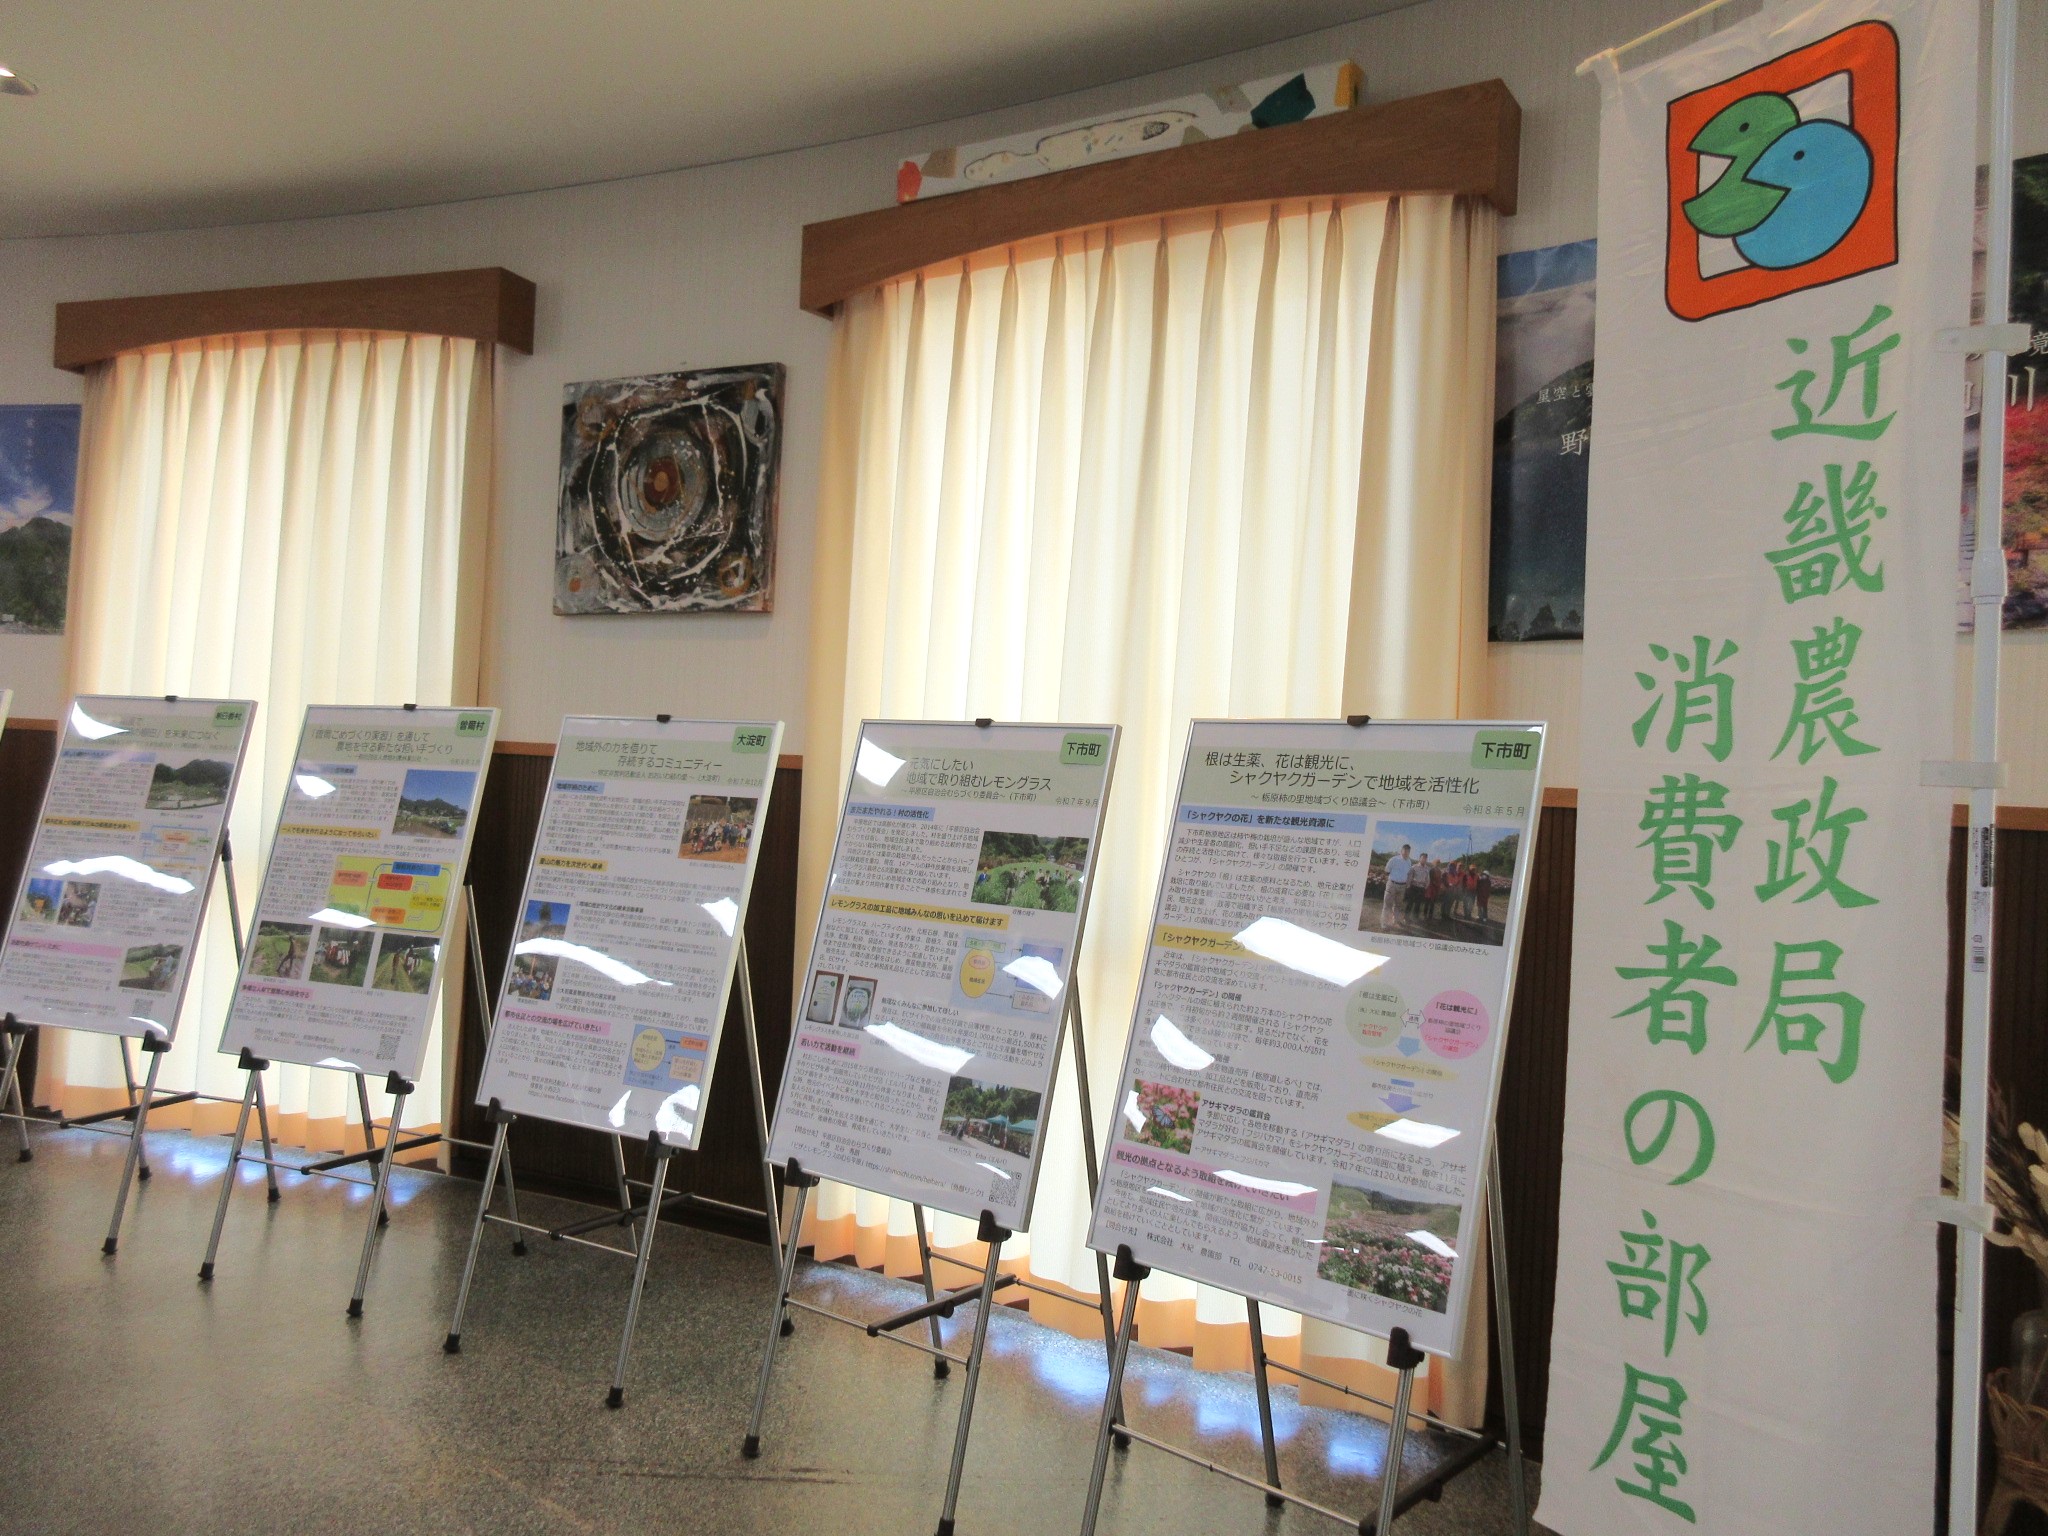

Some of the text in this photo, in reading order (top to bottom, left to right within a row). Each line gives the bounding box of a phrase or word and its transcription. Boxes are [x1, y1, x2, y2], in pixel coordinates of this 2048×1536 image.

[1560, 429, 1589, 456] 野
[1745, 305, 1901, 1084] 近畿農政局
[574, 740, 658, 755] 地域外の力を借りて
[735, 733, 766, 746] 大淀町
[1064, 742, 1101, 756] 下市町
[1203, 751, 1357, 772] 根は生薬、花は観光に、
[1478, 742, 1531, 760] 下市町
[616, 755, 723, 772] 存続するコミュニティー
[905, 770, 1053, 792] 地域で取り組むレモングラス
[1228, 768, 1480, 796] シャクヤクガーデンで地域を活性化
[1184, 809, 1335, 829] 「シャクヤクの花」を新たな観光資源に
[1174, 854, 1317, 874] ひとつが、「シャクヤクガーデン」の開催です。
[1175, 845, 1358, 868] の存続と活性化に向けて、様々な取組を行っています。その
[1177, 868, 1353, 892] シャクヤクの「根」は生薬の原料となるため、地元企業が
[1153, 981, 1242, 1002] 「シャクヤクガーデン」の開催
[1590, 635, 1743, 1524] 消費者の部屋
[1201, 1098, 1270, 1121] アサギマダラの鑑賞会
[1146, 1230, 1174, 1247] 株式会社
[1228, 1255, 1242, 1267] TEL
